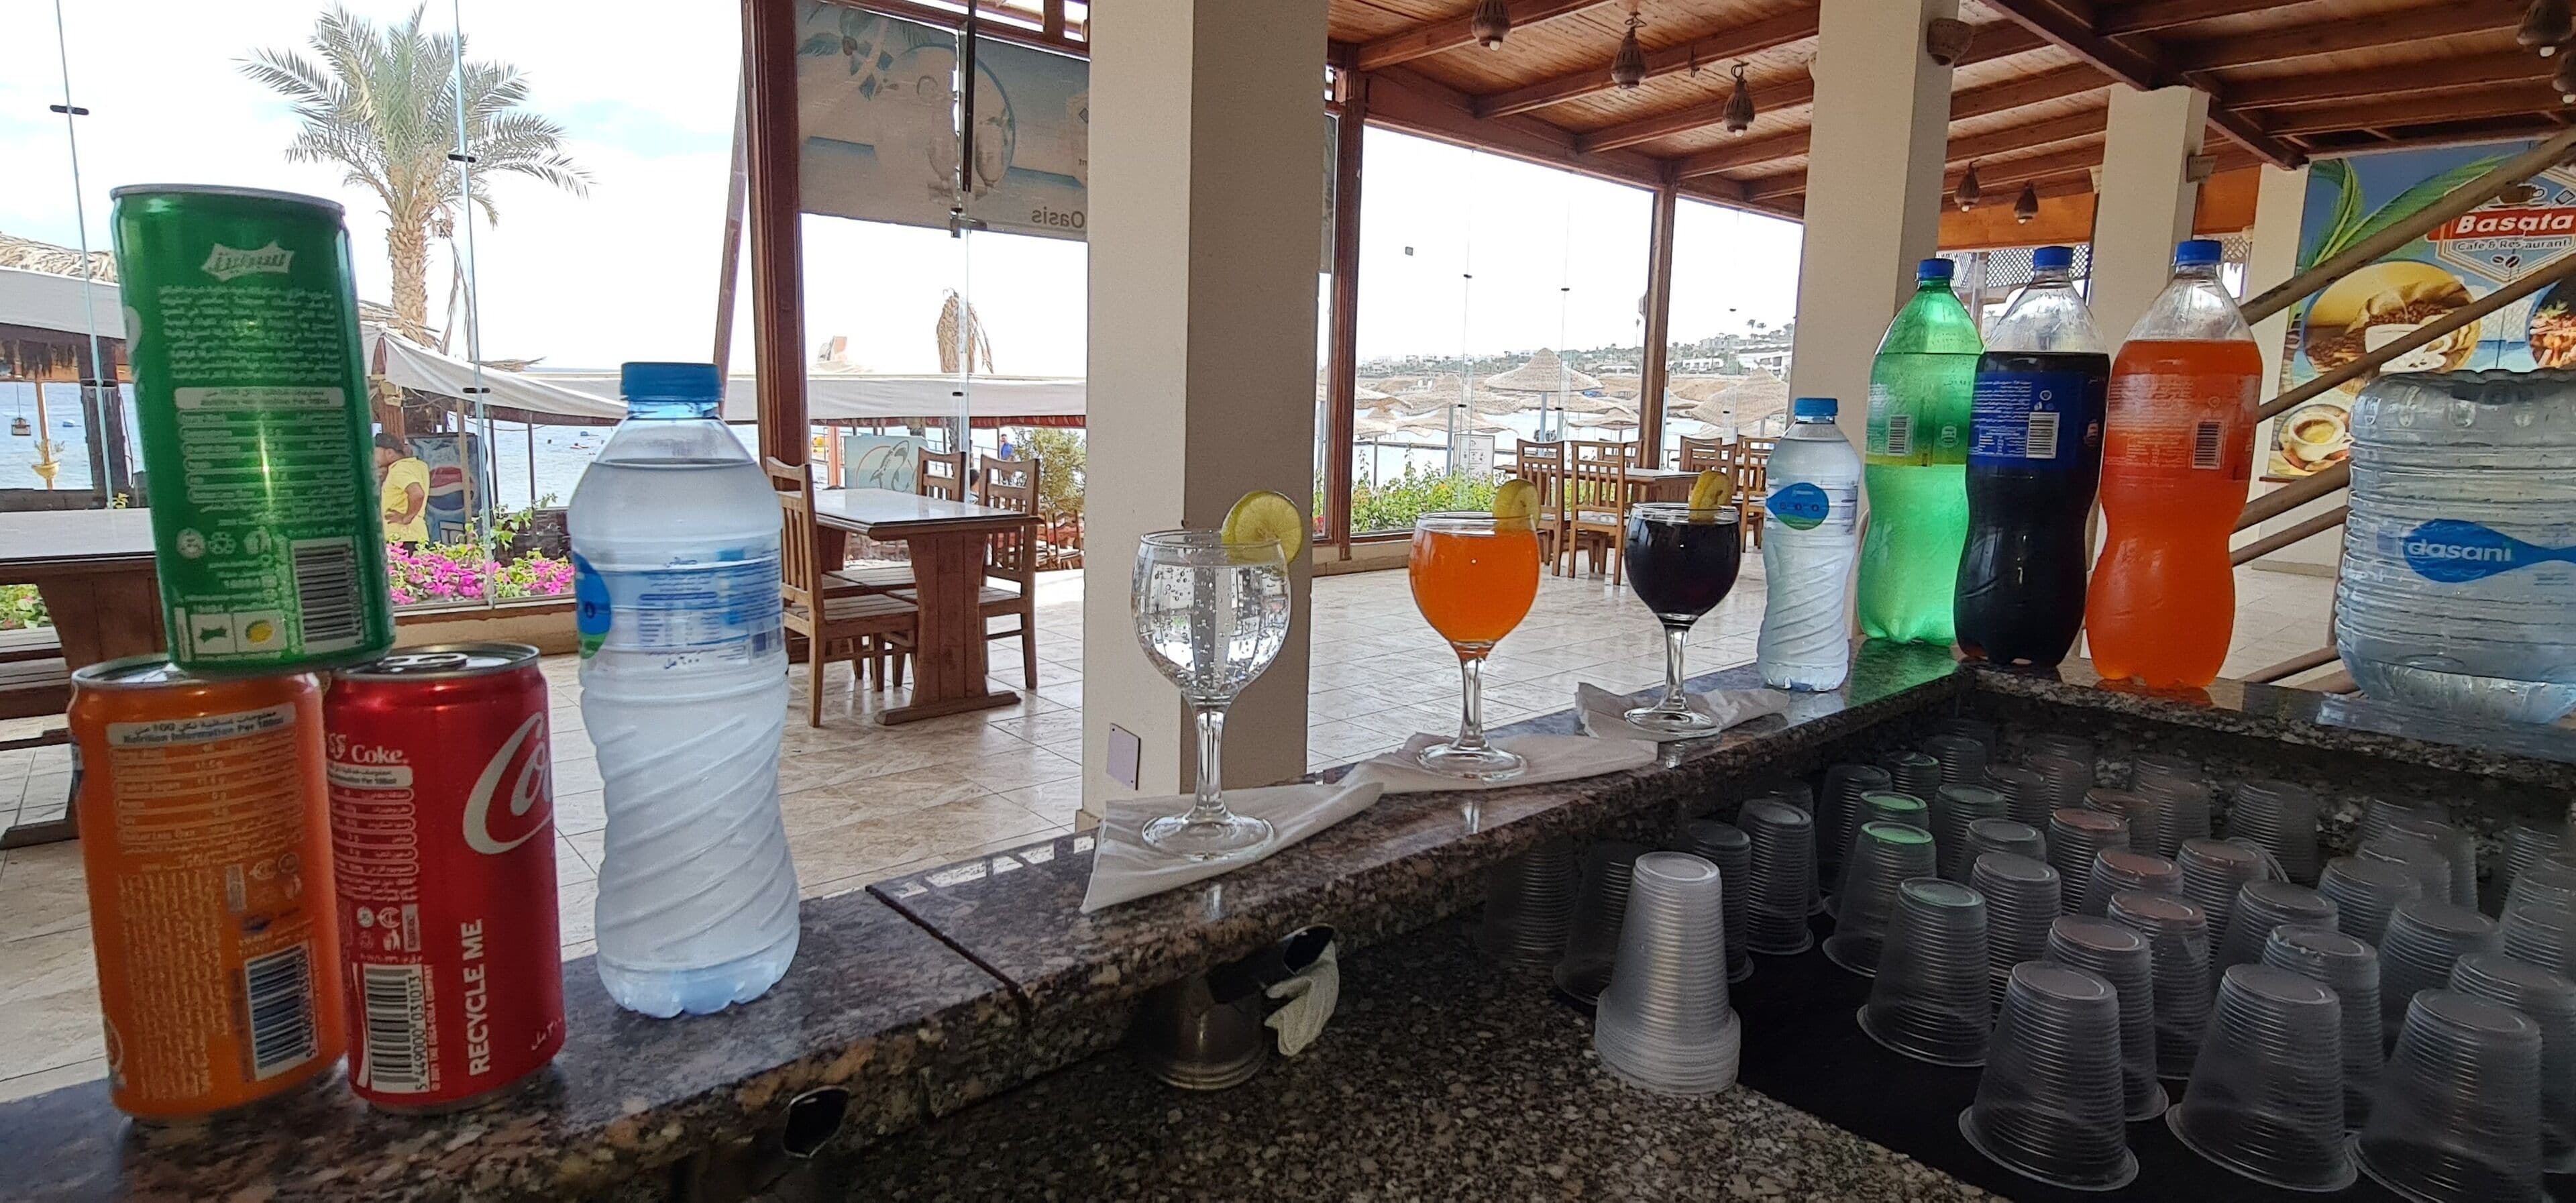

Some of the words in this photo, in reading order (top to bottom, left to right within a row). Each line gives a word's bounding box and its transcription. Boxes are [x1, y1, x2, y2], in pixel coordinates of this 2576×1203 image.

[2455, 212, 2575, 234] Basata
[2457, 241, 2485, 251] Cafe
[2500, 239, 2567, 249] Resaurant
[2407, 540, 2512, 563] dasani
[460, 919, 484, 961] ME
[463, 963, 491, 1076] RECYCLE
